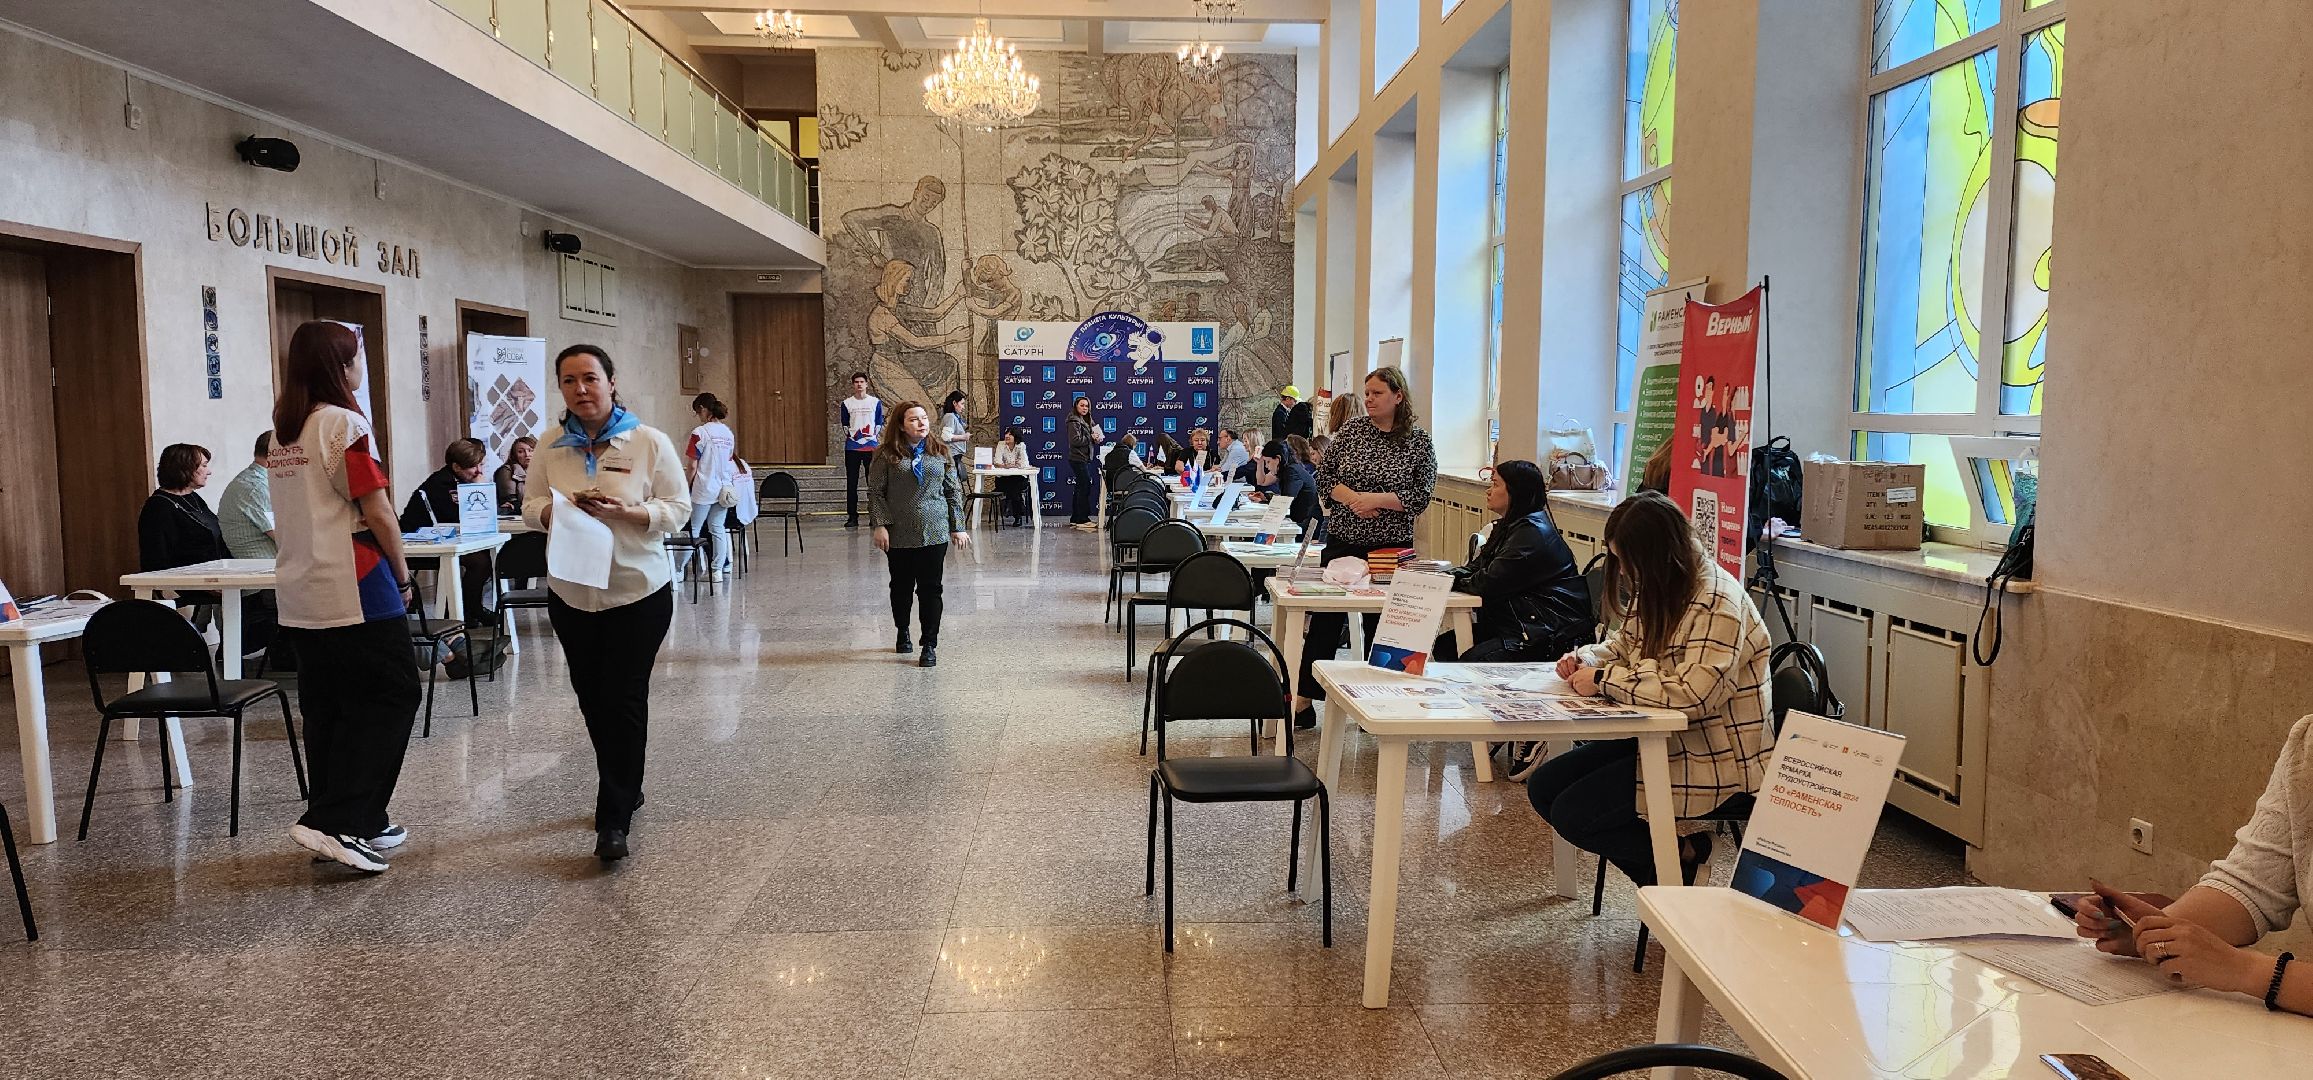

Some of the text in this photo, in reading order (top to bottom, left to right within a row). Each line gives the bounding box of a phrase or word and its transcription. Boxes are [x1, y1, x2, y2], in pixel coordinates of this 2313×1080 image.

[206, 202, 421, 279] БОЛЬШОЙ ЗАЛ
[1080, 315, 1107, 334] ПЛАНЕТА
[1003, 348, 1044, 357] САТУРН
[1780, 763, 1812, 779] ЯРМАРКА
[1783, 755, 1843, 778] ВСЕРОССИЙСКАЯ
[1772, 784, 1843, 812] АО «РАМЕНСКАЯ
[1777, 771, 1860, 802] ТРУДОУСТРОЙСТВА 2024
[1769, 794, 1822, 817] ТЕПЛОСЕТЬ»
